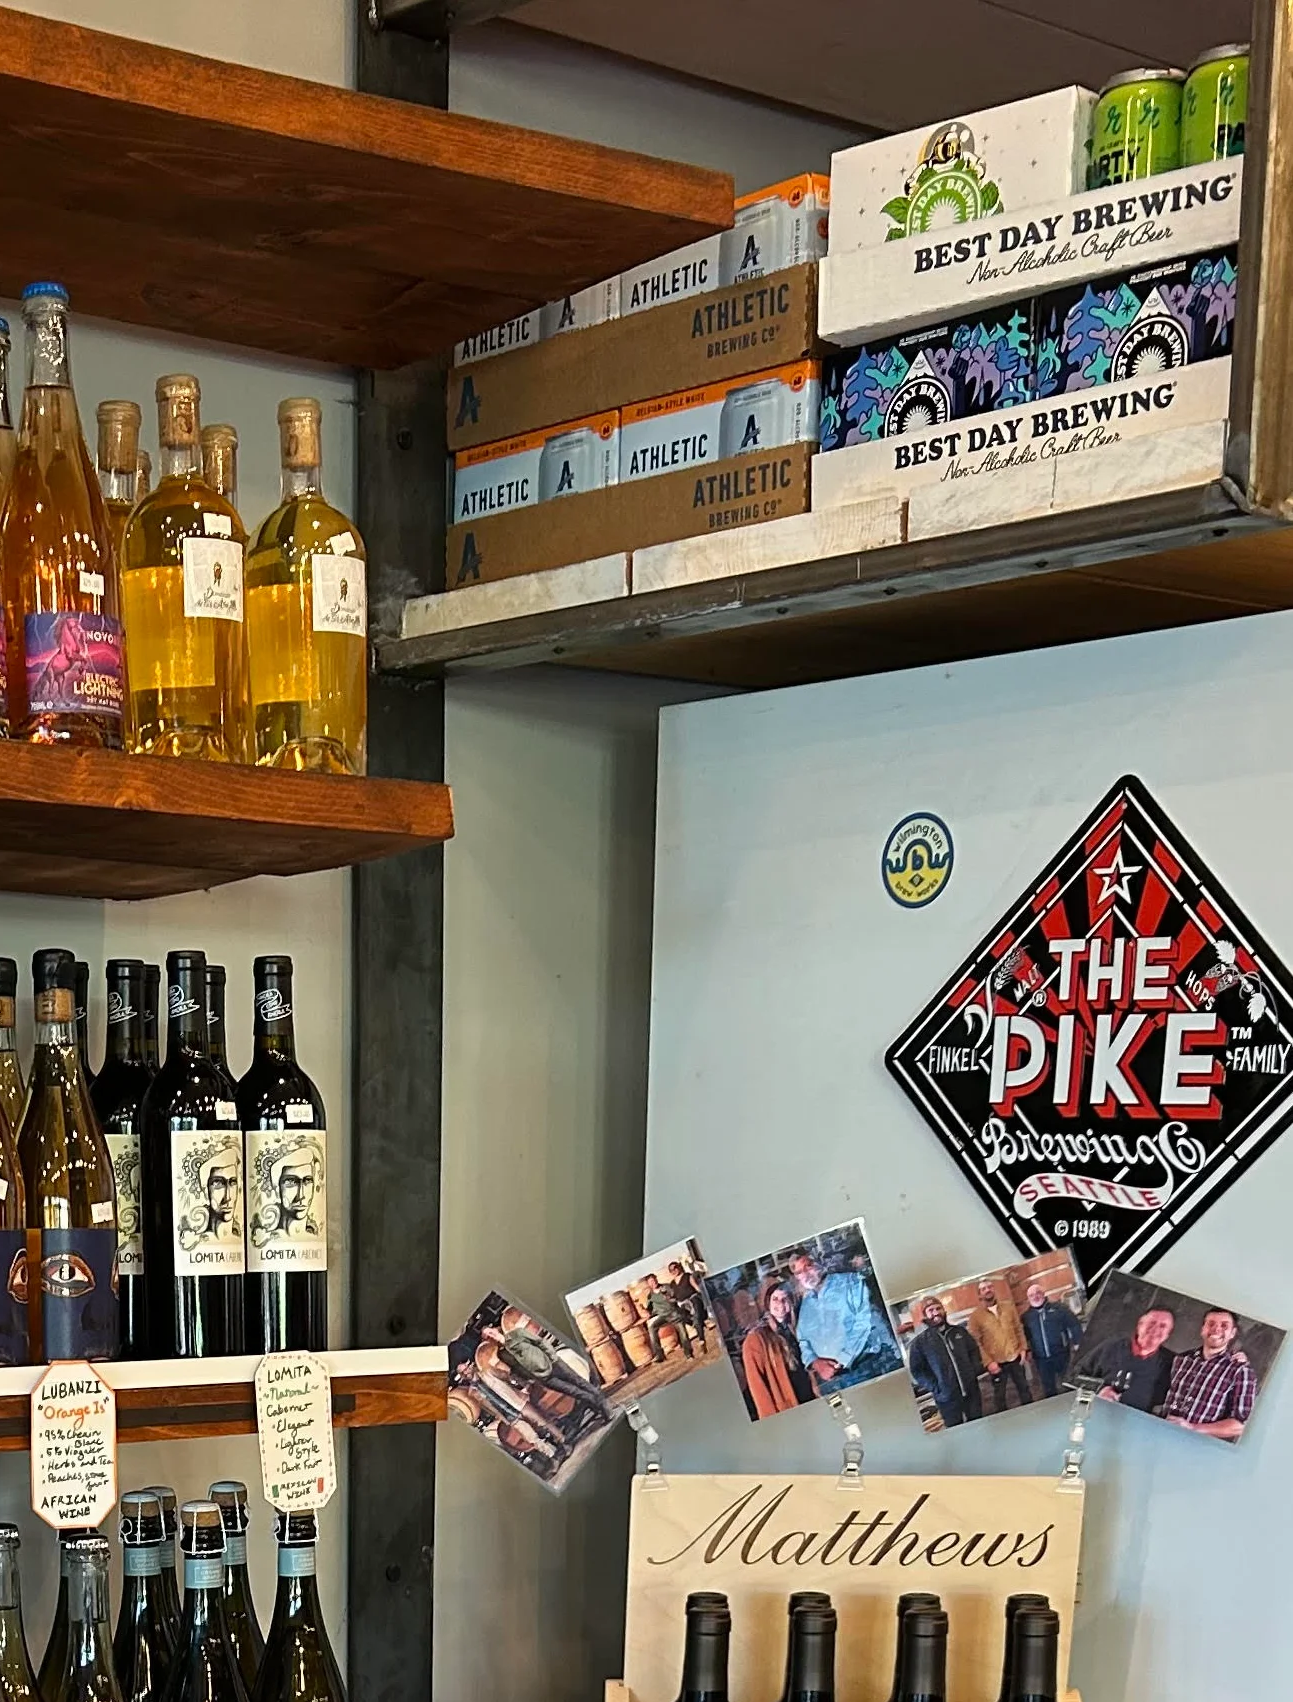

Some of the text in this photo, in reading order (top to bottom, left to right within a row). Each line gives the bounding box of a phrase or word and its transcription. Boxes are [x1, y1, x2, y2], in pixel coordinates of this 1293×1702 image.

[914, 174, 1234, 273] BEST DAY BREWING
[967, 222, 1174, 284] Non-Alcoholic Craft Beer
[631, 258, 708, 308] ATHLETIC
[692, 284, 790, 339] ATHLETIC
[707, 335, 758, 359] BREWING
[895, 383, 1176, 470] BEST DAY BREWING
[630, 434, 708, 475] ATHLETIC
[941, 427, 1122, 481] Non-Alcoholic Craft Beer
[462, 479, 529, 516] ATHLETIC
[693, 459, 791, 508] ATHLETIC
[709, 503, 759, 528] BREWING
[86, 631, 114, 644] NOVO
[893, 823, 943, 852] wilmington
[1014, 963, 1042, 1002] MALT
[1048, 936, 1176, 1006] THE
[1185, 970, 1216, 1011] HOPS
[928, 1045, 979, 1073] FINKEL
[988, 1013, 1223, 1115] PIKE
[1233, 1044, 1289, 1074] FAMILY
[982, 1115, 1166, 1173] Brewing
[1019, 1180, 1162, 1209] SEATTLE
[1072, 1220, 1110, 1239] 1989
[189, 1251, 226, 1264] LOMITA
[259, 1247, 296, 1260] LOMITA
[42, 1380, 102, 1400] LUBANZI
[267, 1366, 312, 1383] LOMITA
[45, 1430, 65, 1441] 95%
[41, 1494, 97, 1509] AFRICAN
[59, 1506, 91, 1520] WINE
[646, 1483, 1056, 1569] Matthews
